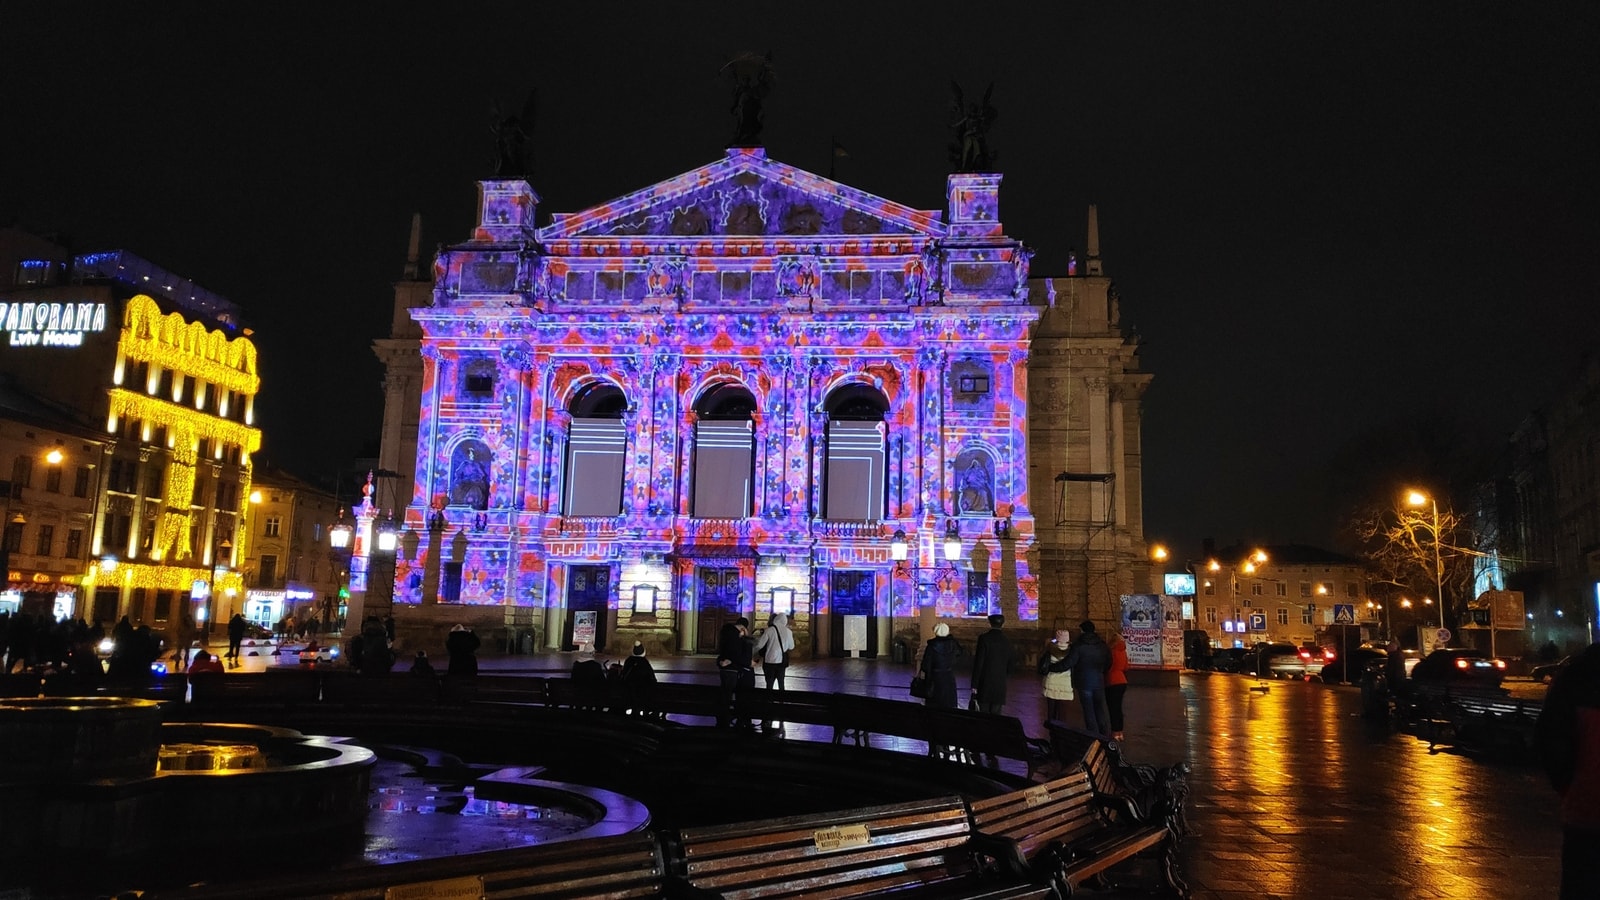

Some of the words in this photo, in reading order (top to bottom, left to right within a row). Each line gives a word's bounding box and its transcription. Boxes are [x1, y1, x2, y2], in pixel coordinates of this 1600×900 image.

[10, 331, 40, 346] Lviv
[43, 331, 82, 347] Hotel
[1253, 615, 1262, 628] P
[1128, 635, 1154, 644] Серце
